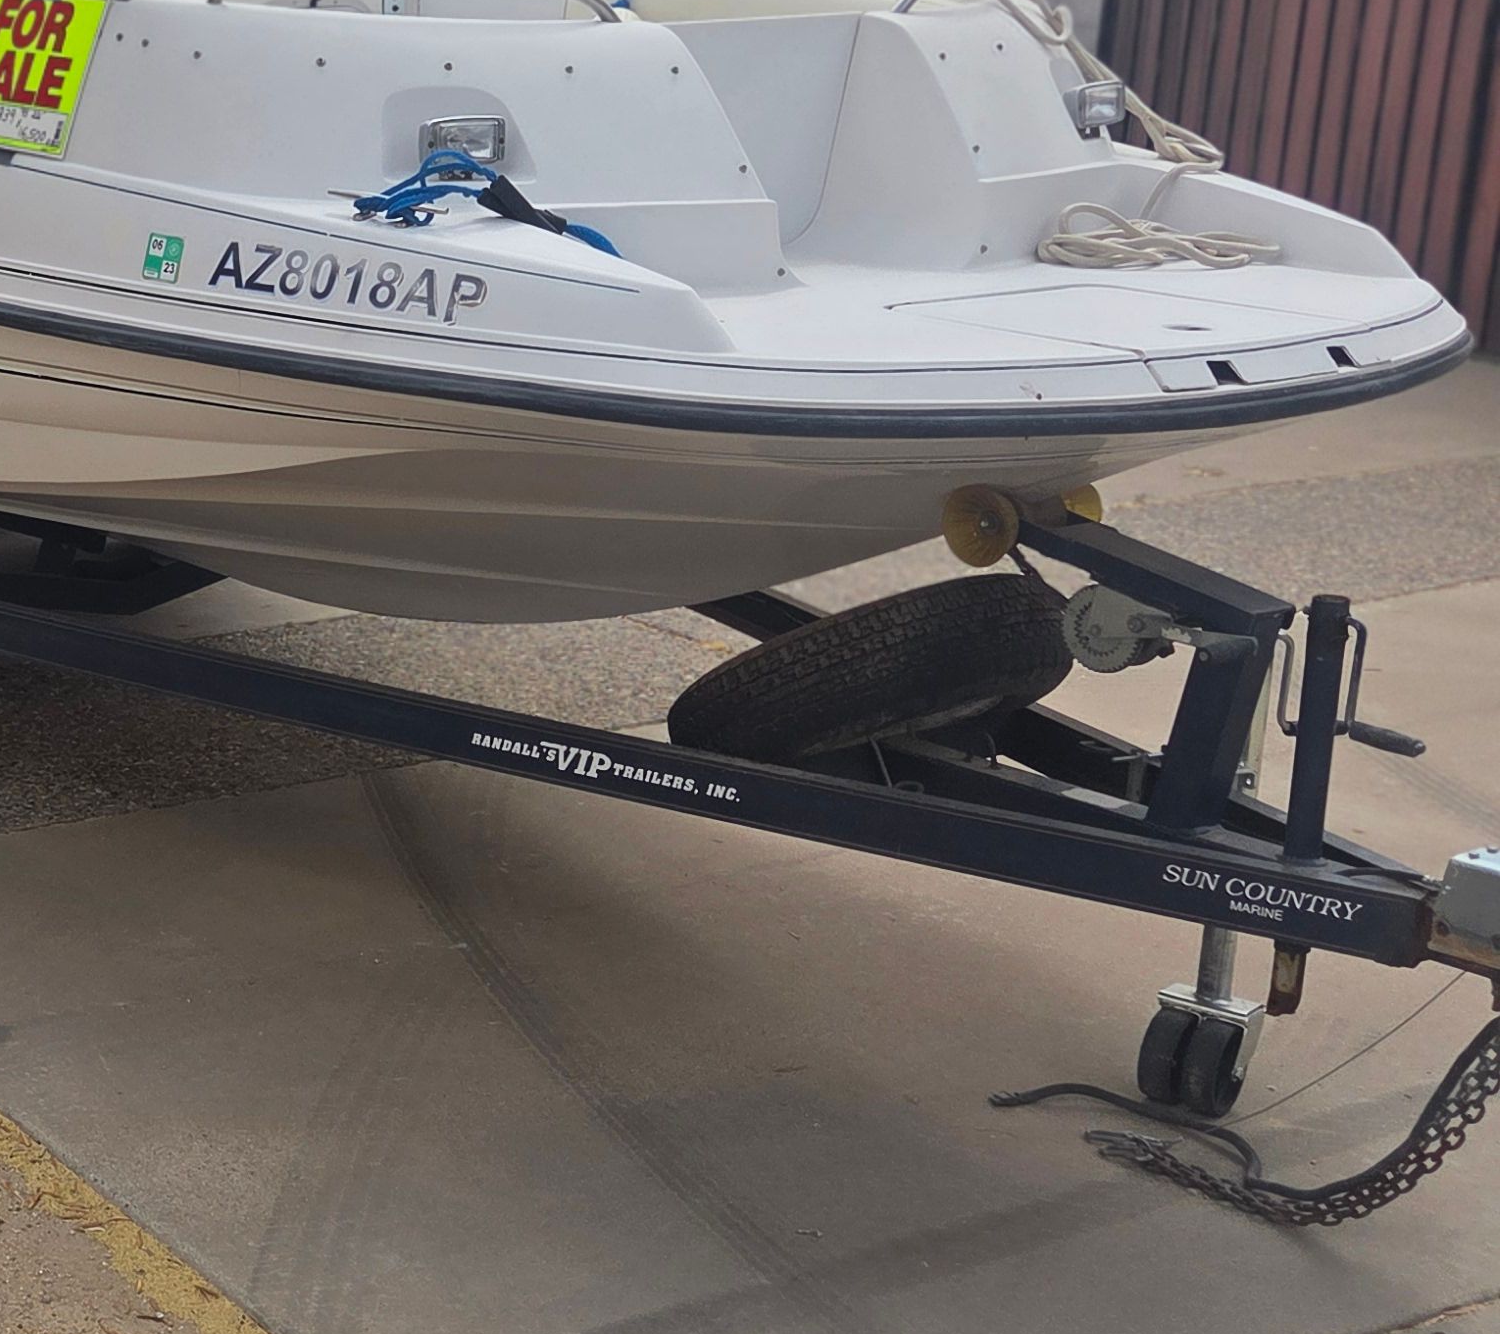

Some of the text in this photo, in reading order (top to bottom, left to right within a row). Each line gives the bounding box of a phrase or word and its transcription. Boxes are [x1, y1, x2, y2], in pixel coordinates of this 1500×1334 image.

[152, 238, 164, 251] 06
[163, 261, 176, 275] 23
[208, 241, 488, 326] AZ8018AP
[471, 732, 741, 803] RANDALL'S VIP TRAILERS, INC.
[1162, 864, 1363, 921] SUN COUNTRY
[1229, 900, 1284, 921] MARINE
